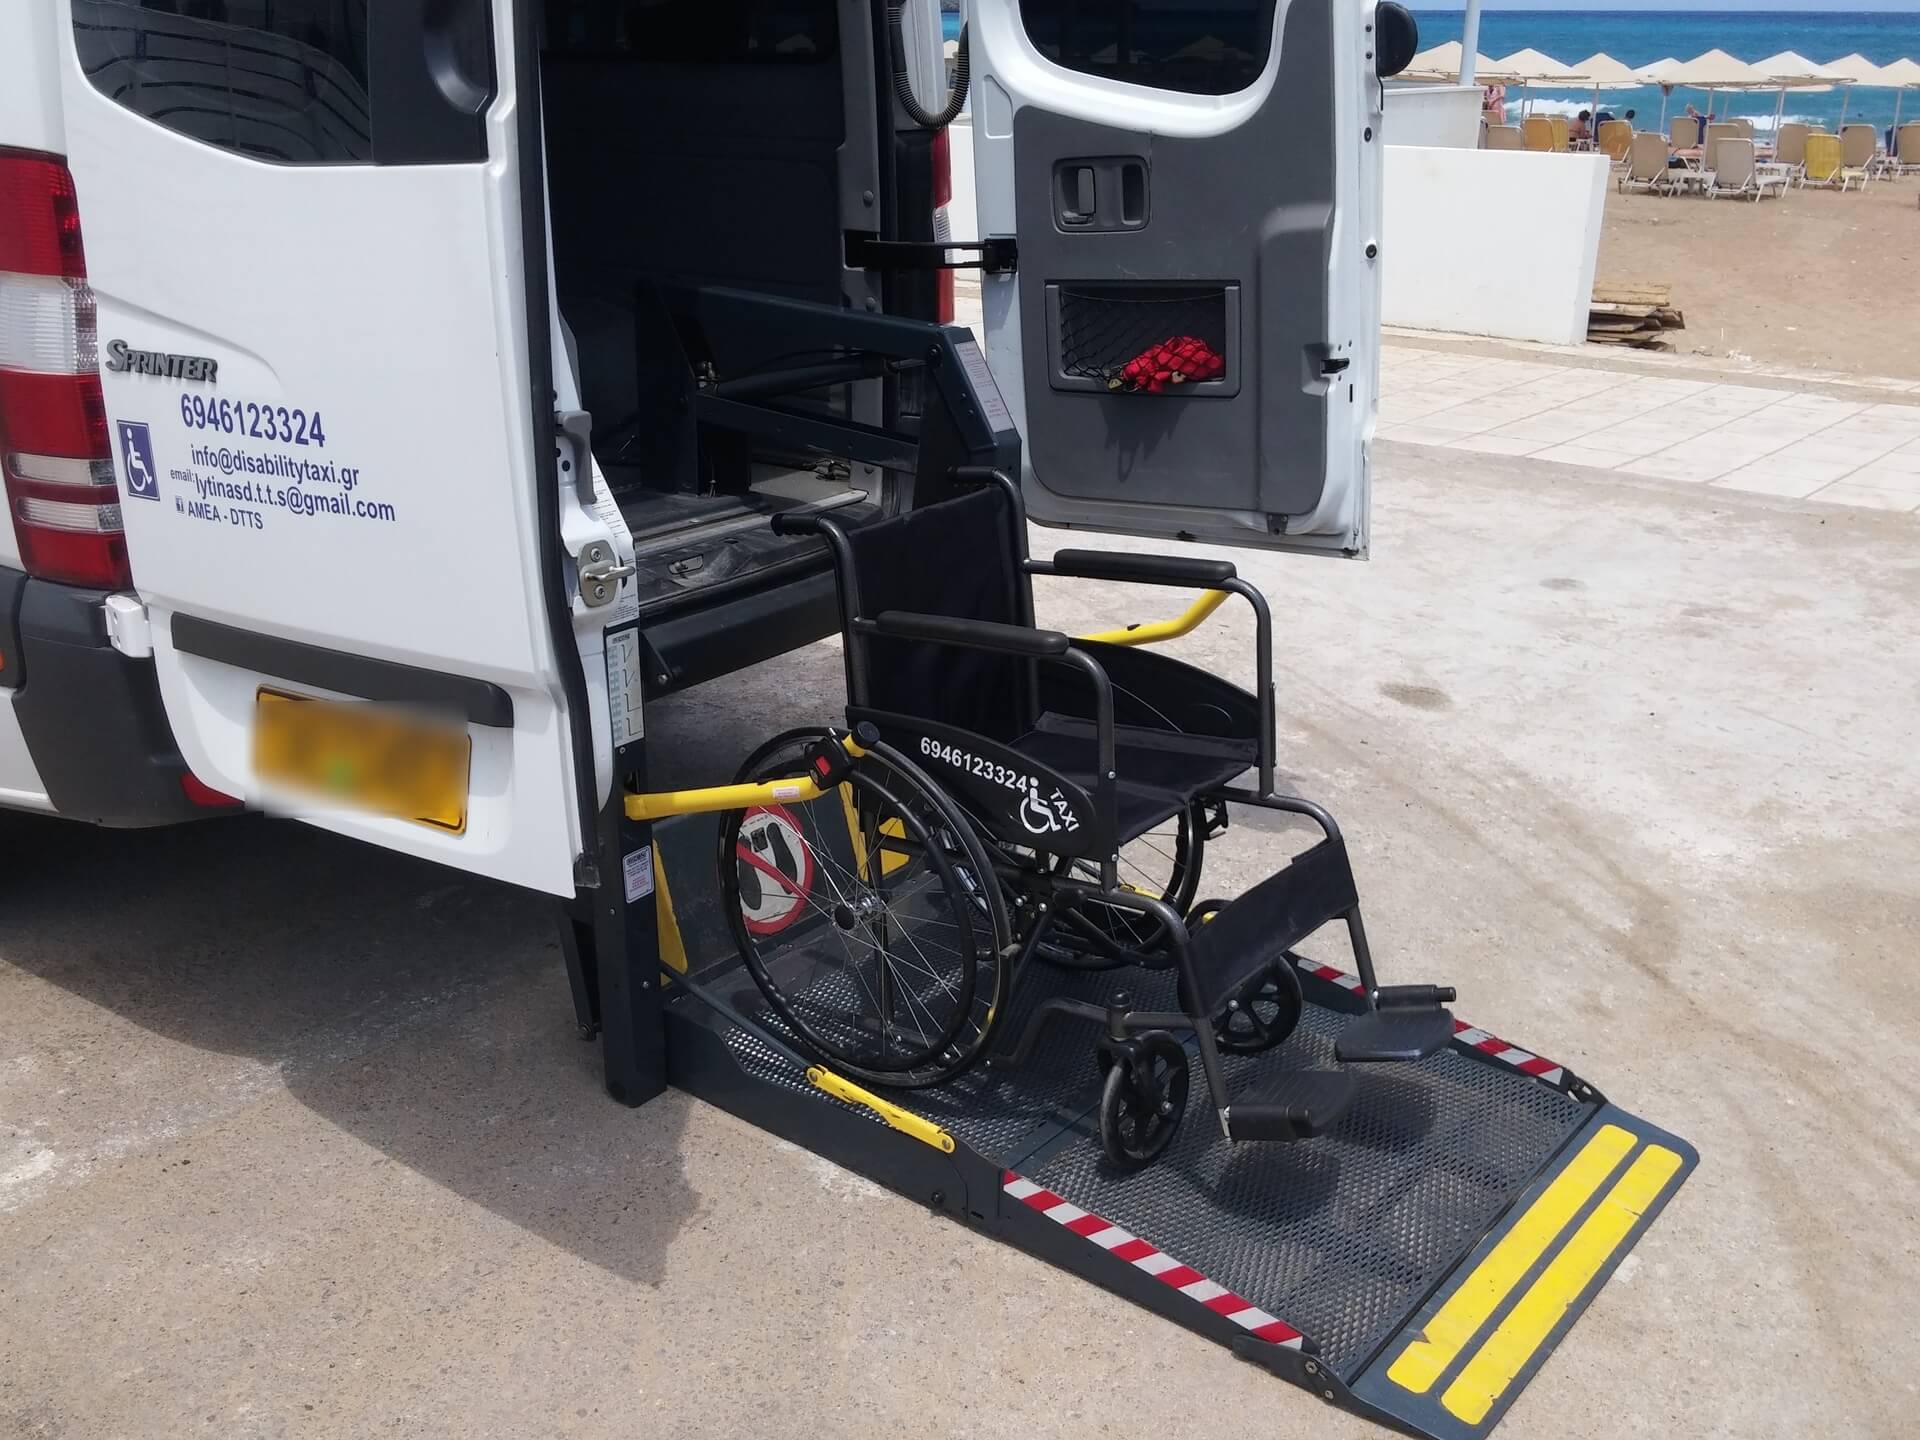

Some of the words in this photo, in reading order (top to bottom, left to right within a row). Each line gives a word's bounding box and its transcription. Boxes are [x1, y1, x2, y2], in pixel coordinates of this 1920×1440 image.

[181, 393, 325, 448] 6946123324
[190, 444, 360, 490] info@disabilitytaxi.gr
[188, 500, 222, 522] AMEA
[230, 507, 263, 530] DTTS
[195, 473, 396, 522] lytinasd.t.t.s@gmail.com
[920, 737, 1027, 793] 6946123324
[1050, 787, 1080, 832] TAXI
